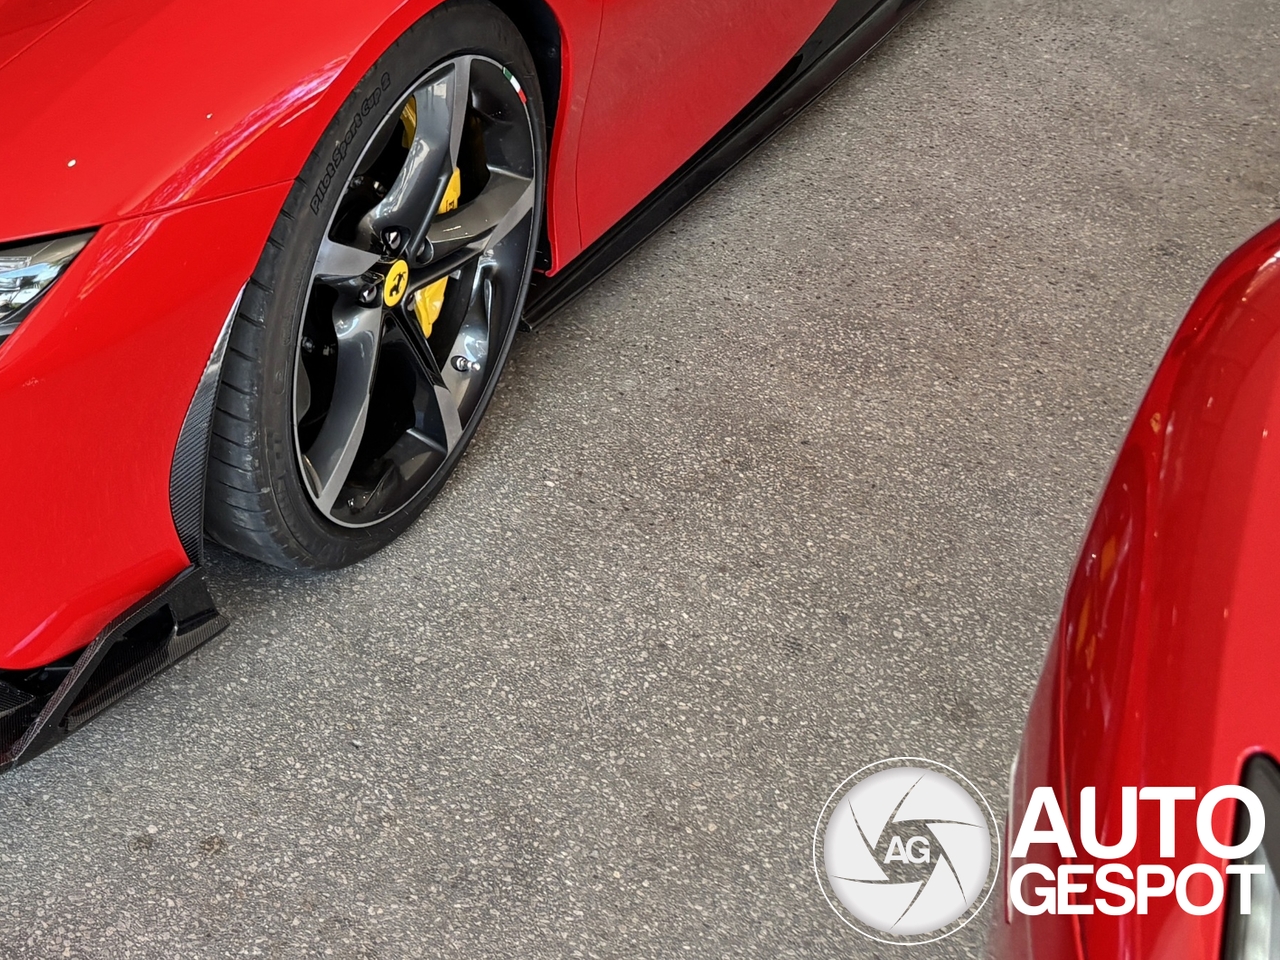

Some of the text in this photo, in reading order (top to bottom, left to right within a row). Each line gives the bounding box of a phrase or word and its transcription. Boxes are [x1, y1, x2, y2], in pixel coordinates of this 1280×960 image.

[310, 71, 392, 215] Pilot Sport Cup 2
